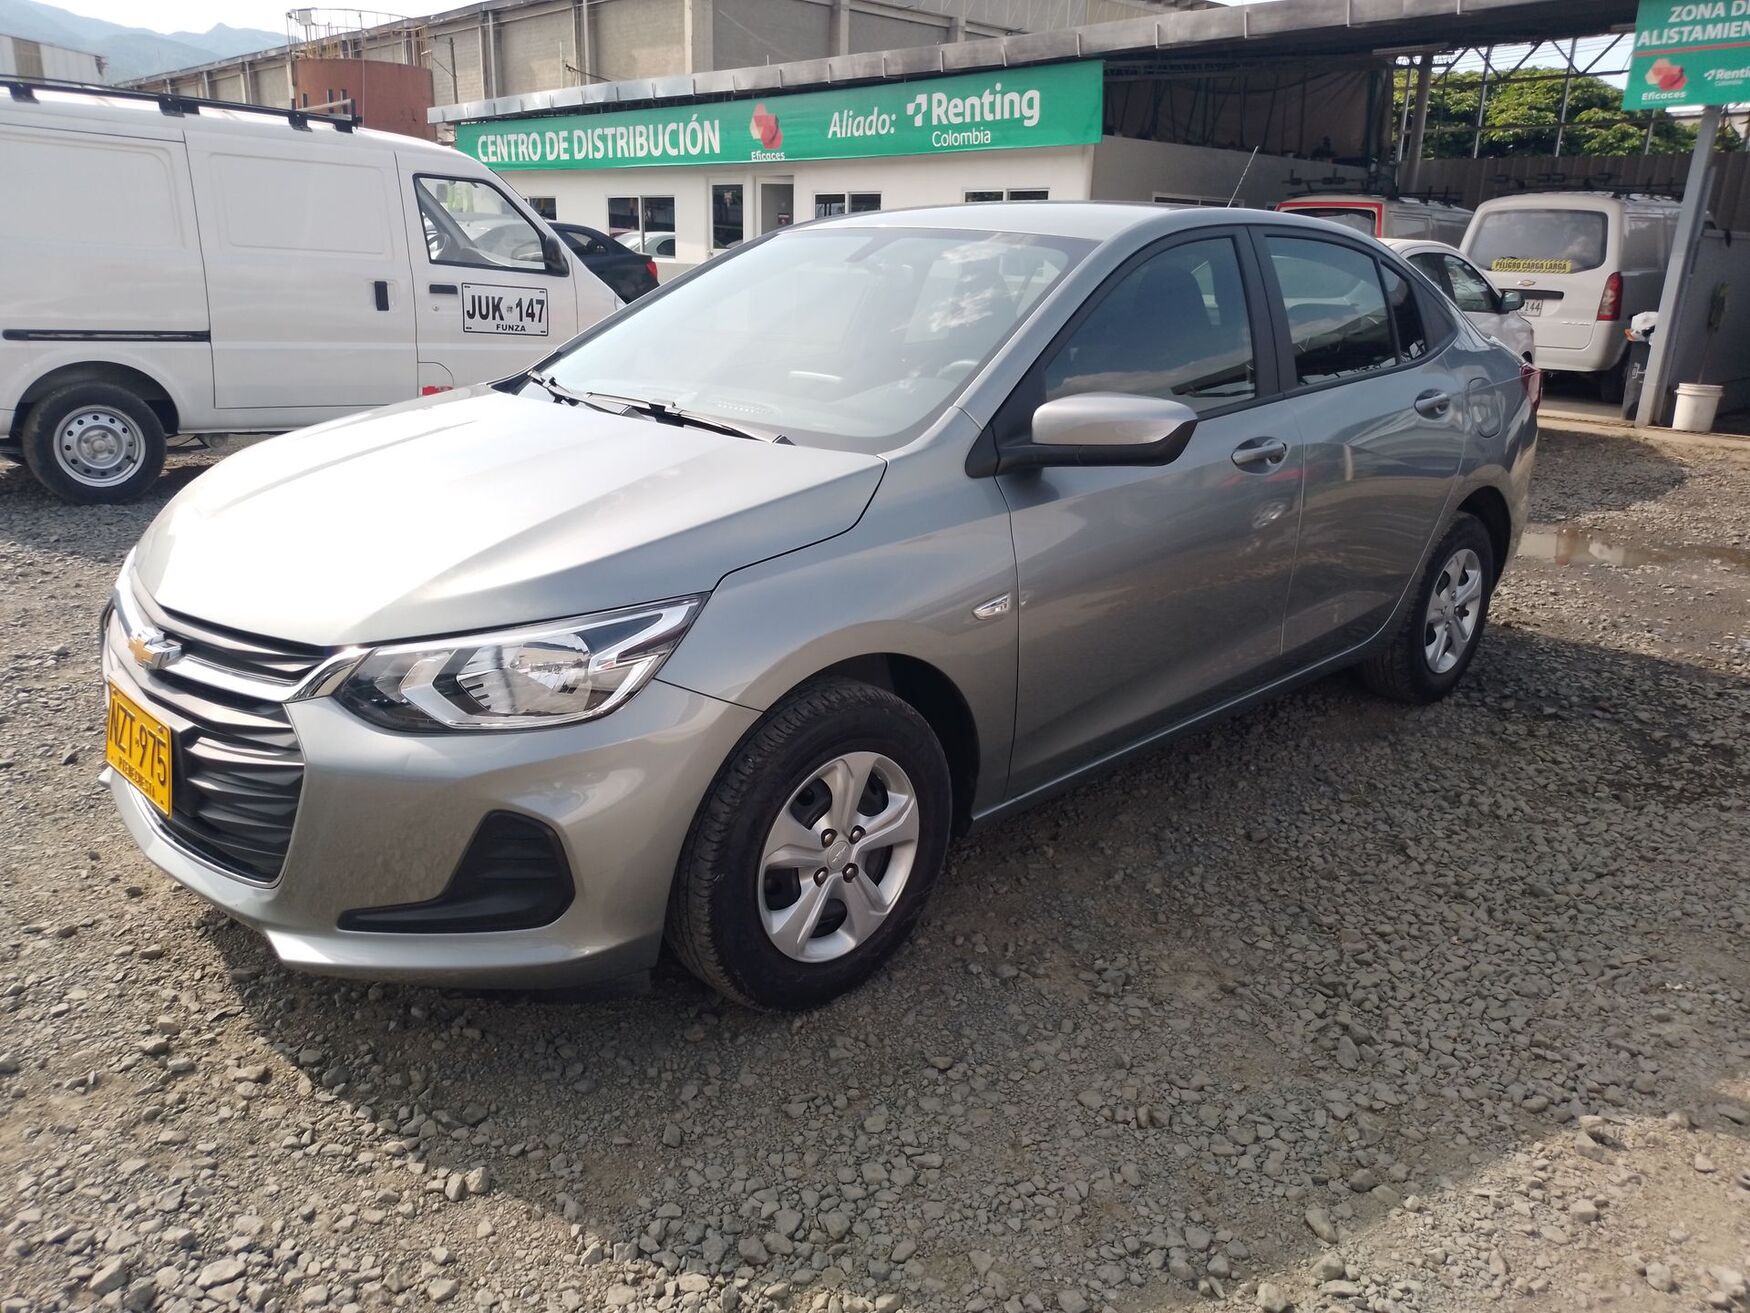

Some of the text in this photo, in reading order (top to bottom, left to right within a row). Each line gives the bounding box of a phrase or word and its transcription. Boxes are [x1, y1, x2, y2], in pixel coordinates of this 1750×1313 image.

[1668, 0, 1750, 23] ZONA D
[931, 82, 1041, 127] Renting
[1641, 91, 1687, 101] Eficaces
[828, 106, 897, 139] Aliado:
[477, 114, 720, 162] CENTRO DE DISTRIBUCIÓN
[932, 127, 991, 147] Colombia
[751, 150, 785, 161] Eficaces
[1495, 261, 1521, 269] PELIGRO
[1522, 262, 1544, 270] CARGA
[466, 295, 545, 323] JUK 147
[496, 323, 526, 332] FUNZA
[110, 698, 167, 786] NZT 975
